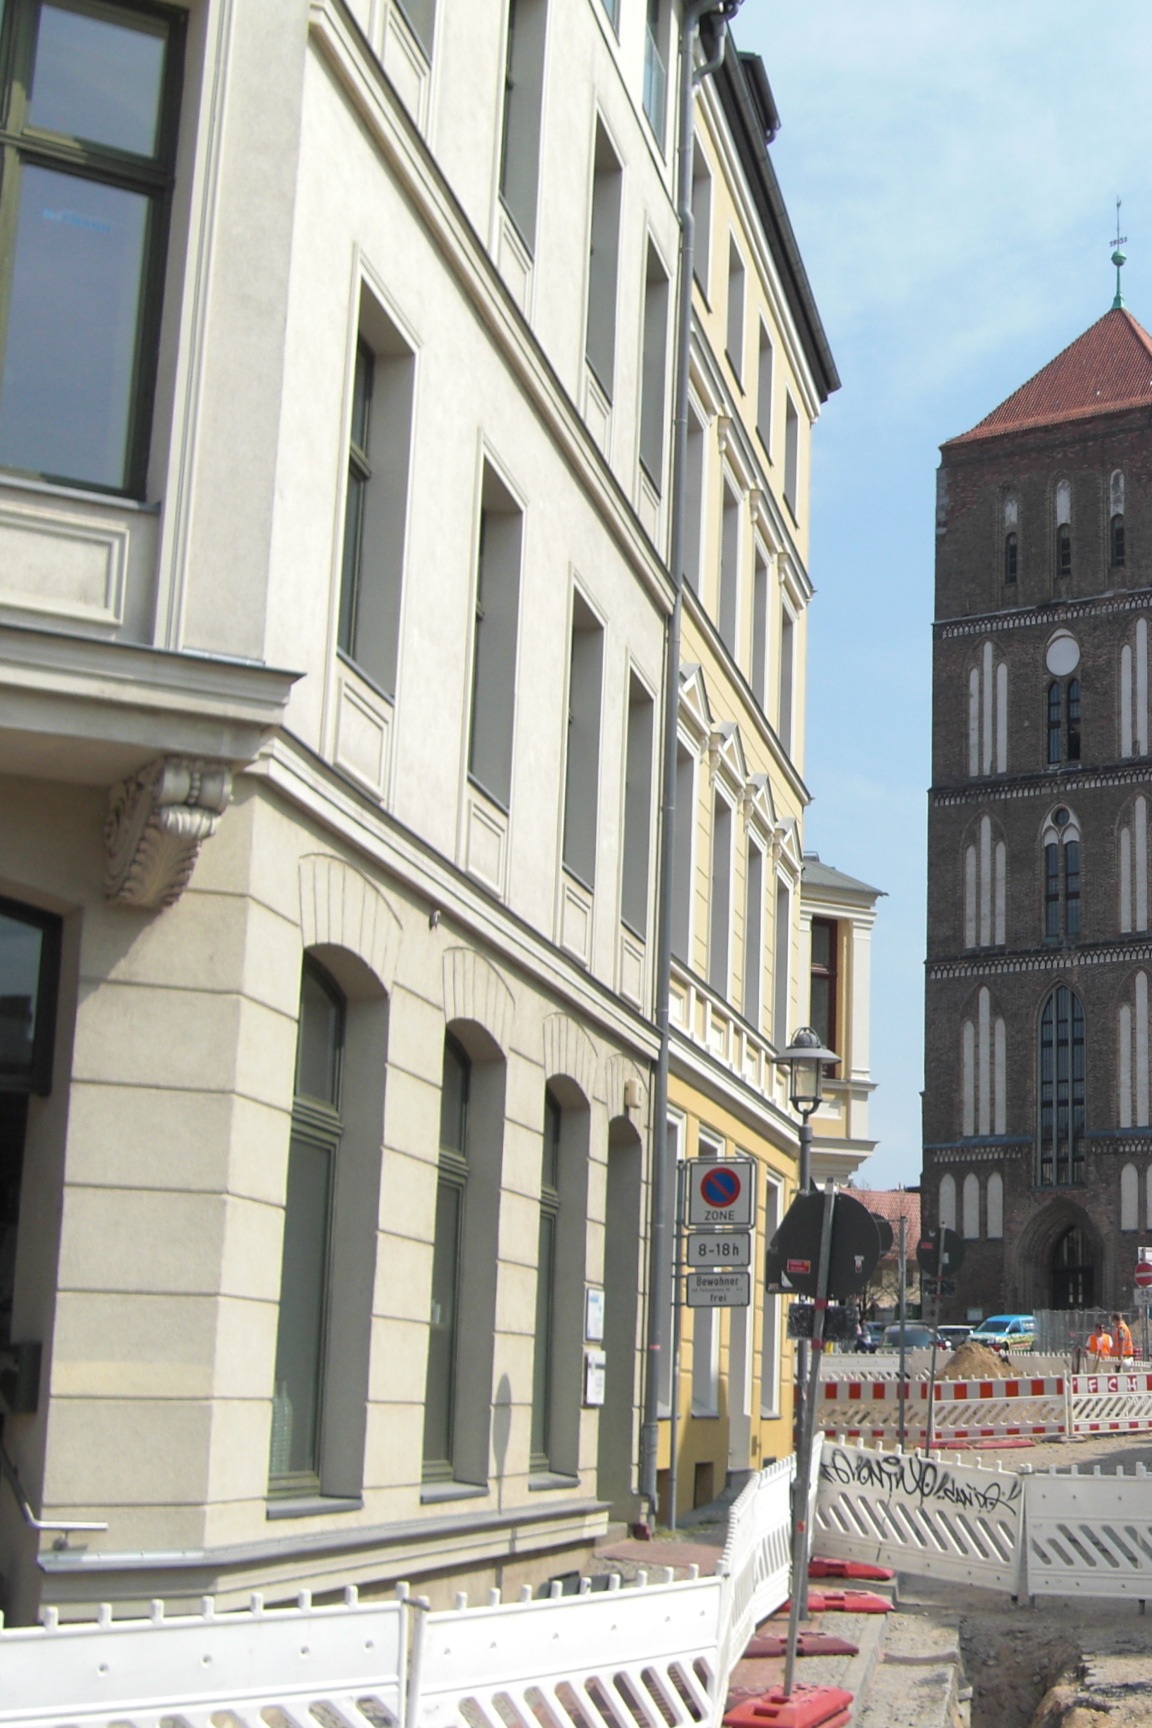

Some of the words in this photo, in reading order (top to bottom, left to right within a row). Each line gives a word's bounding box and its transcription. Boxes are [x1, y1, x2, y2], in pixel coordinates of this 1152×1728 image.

[704, 1210, 735, 1221] ZONE
[696, 1276, 739, 1287] Bewohner
[709, 1293, 727, 1302] frei
